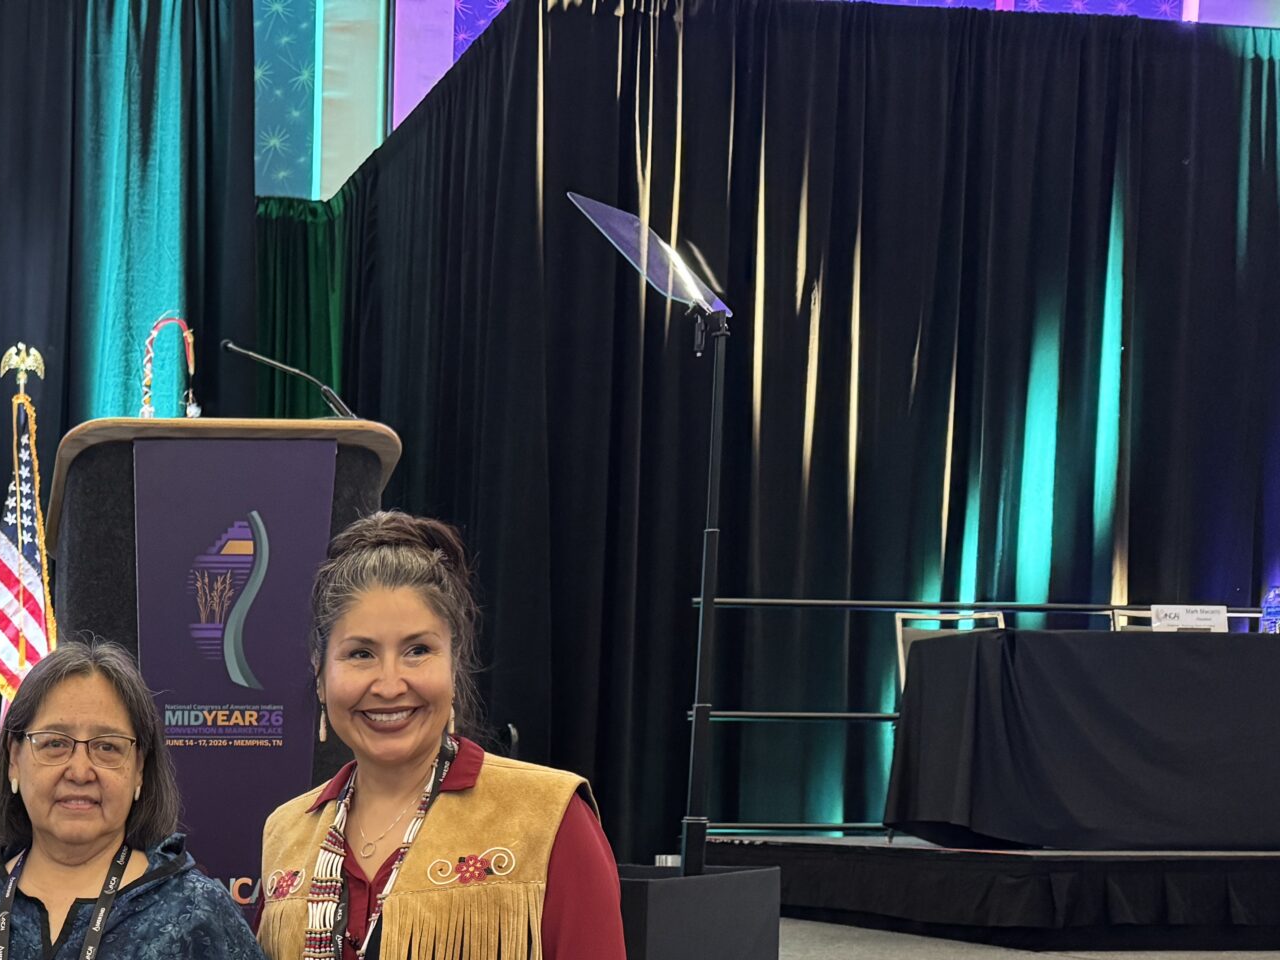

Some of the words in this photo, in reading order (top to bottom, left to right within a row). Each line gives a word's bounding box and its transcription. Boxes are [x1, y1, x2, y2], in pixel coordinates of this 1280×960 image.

[193, 703, 221, 711] Congress
[164, 710, 283, 726] MIDYEAR26
[199, 739, 208, 747] 17,
[233, 739, 271, 747] MEMPHIS,
[92, 907, 106, 932] AMERIND
